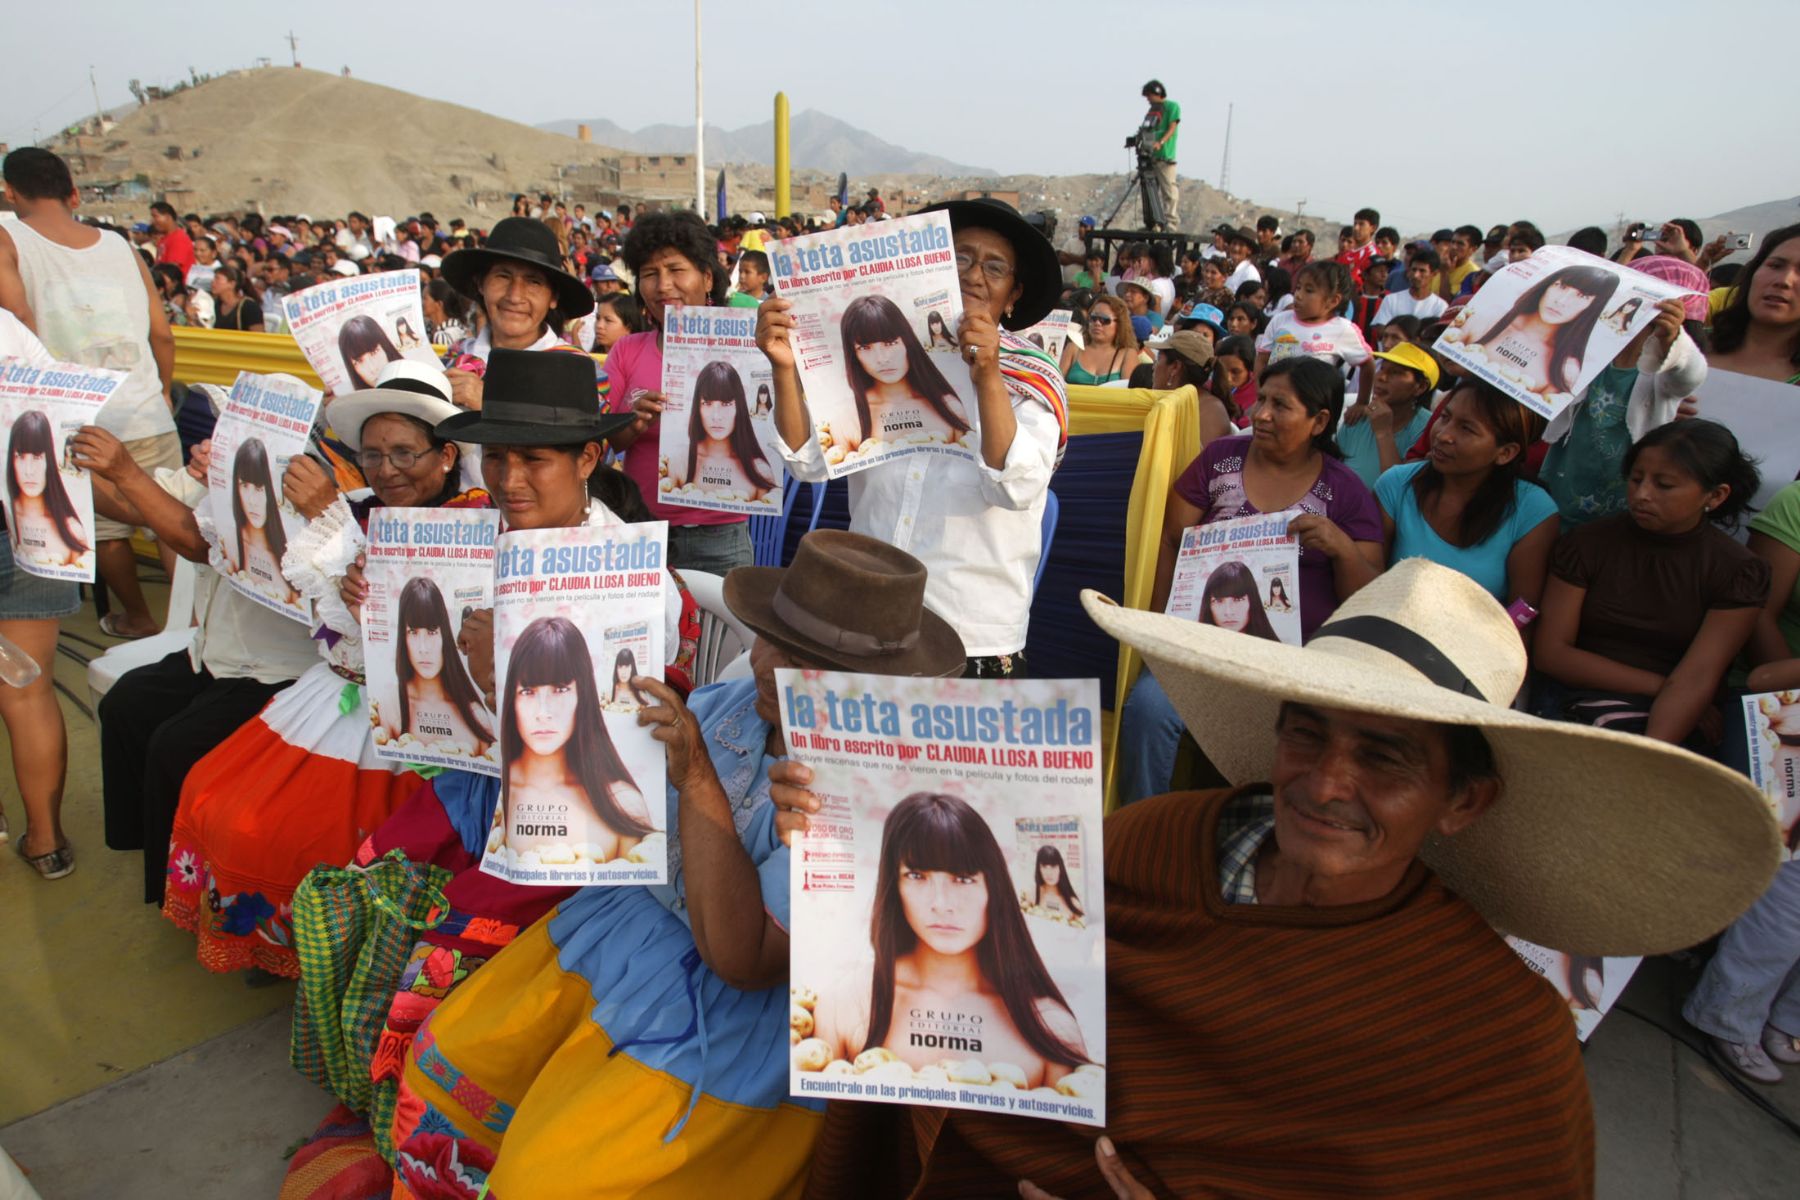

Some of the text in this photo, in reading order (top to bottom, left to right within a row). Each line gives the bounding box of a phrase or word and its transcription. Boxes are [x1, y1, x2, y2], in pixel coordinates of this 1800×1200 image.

[772, 224, 949, 277] la teta asustada
[778, 279, 790, 290] Un
[791, 276, 810, 288] libro
[811, 271, 841, 285] escrito
[843, 269, 858, 281] por
[859, 262, 894, 277] CLAUDIA
[896, 256, 922, 270] LLOSA
[924, 250, 952, 265] BUENO
[304, 289, 337, 311] teta
[341, 274, 416, 298] asustada
[667, 313, 756, 337] la teta asust
[744, 339, 757, 348] LLOS
[1495, 346, 1528, 368] norma
[6, 364, 118, 394] teta asustada
[260, 391, 315, 422] asustada
[883, 420, 923, 433] norma
[702, 476, 731, 486] norma
[378, 518, 494, 546] teta asustada
[1199, 528, 1225, 546] teta
[1228, 518, 1288, 542] asustad
[419, 547, 445, 558] CLAUDIA
[447, 548, 468, 558] LLOSA
[470, 549, 494, 559] BUENO
[542, 536, 661, 574] asustada
[250, 566, 273, 581] norma
[529, 581, 546, 594] por
[549, 577, 590, 591] CLAUDIA
[594, 575, 624, 589] LLOSA
[627, 572, 660, 587] BUENO
[566, 593, 572, 601] la
[601, 593, 606, 601] y
[626, 590, 636, 599] del
[638, 589, 660, 599] rodaje
[785, 686, 1092, 745] la teta asustada
[419, 724, 452, 736] norma
[790, 731, 1094, 769] Un libro escrito por CLAUDIA LLOSA BUENO
[825, 757, 860, 767] escenas
[862, 761, 879, 770] que
[896, 764, 906, 772] se
[909, 764, 937, 775] vieron
[940, 768, 952, 776] en
[954, 768, 963, 776] la
[1005, 772, 1012, 782] y
[1015, 771, 1039, 783] fotos
[1043, 772, 1058, 783] del
[1061, 774, 1093, 787] rodaje
[1784, 758, 1795, 798] norma
[517, 804, 568, 812] GRUPO
[516, 824, 568, 836] norma
[589, 871, 595, 882] y
[910, 1021, 982, 1034] EDITORIAL
[911, 1009, 983, 1024] GRUPO
[911, 1032, 982, 1052] norma
[865, 1083, 877, 1095] en
[880, 1083, 895, 1097] las
[898, 1086, 956, 1102] principales
[1009, 1098, 1016, 1109] y
[1018, 1099, 1096, 1119] autoservicios.
